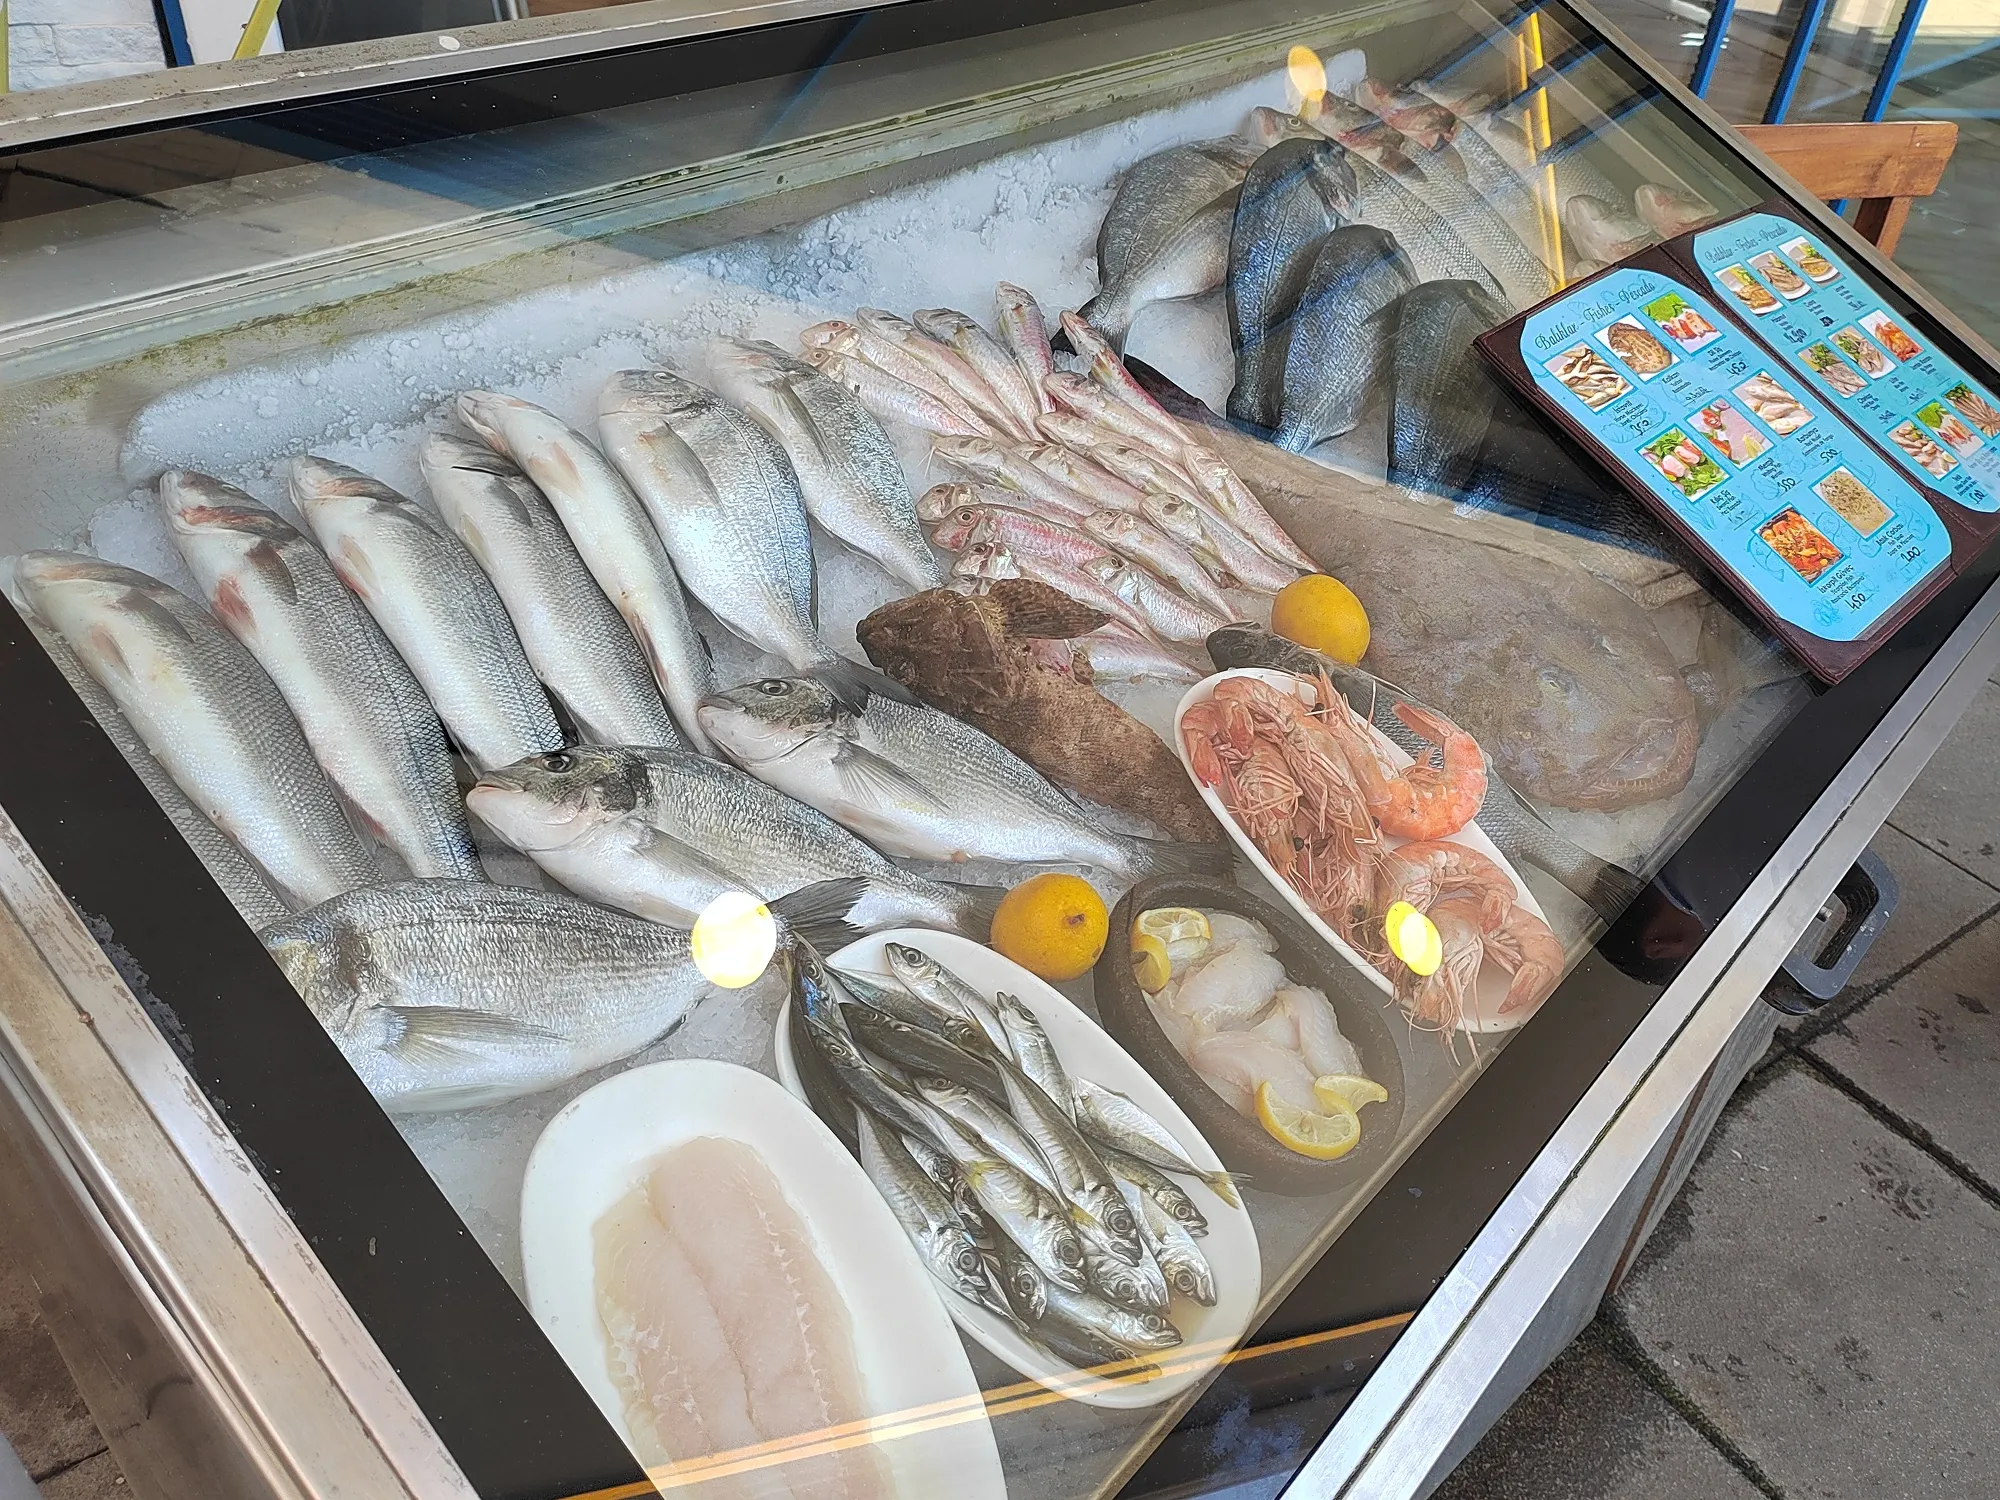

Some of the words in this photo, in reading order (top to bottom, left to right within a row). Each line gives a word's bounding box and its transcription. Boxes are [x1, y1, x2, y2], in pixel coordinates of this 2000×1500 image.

[1736, 235, 1758, 252] Fishes
[1535, 322, 1579, 349] Balıklar
[1583, 302, 1616, 323] Fishes
[1618, 279, 1656, 304] Pescado
[1820, 448, 1839, 463] 500
[1900, 546, 1921, 562] 200
[1836, 564, 1854, 579] Güveç
[1844, 593, 1866, 610] 450
